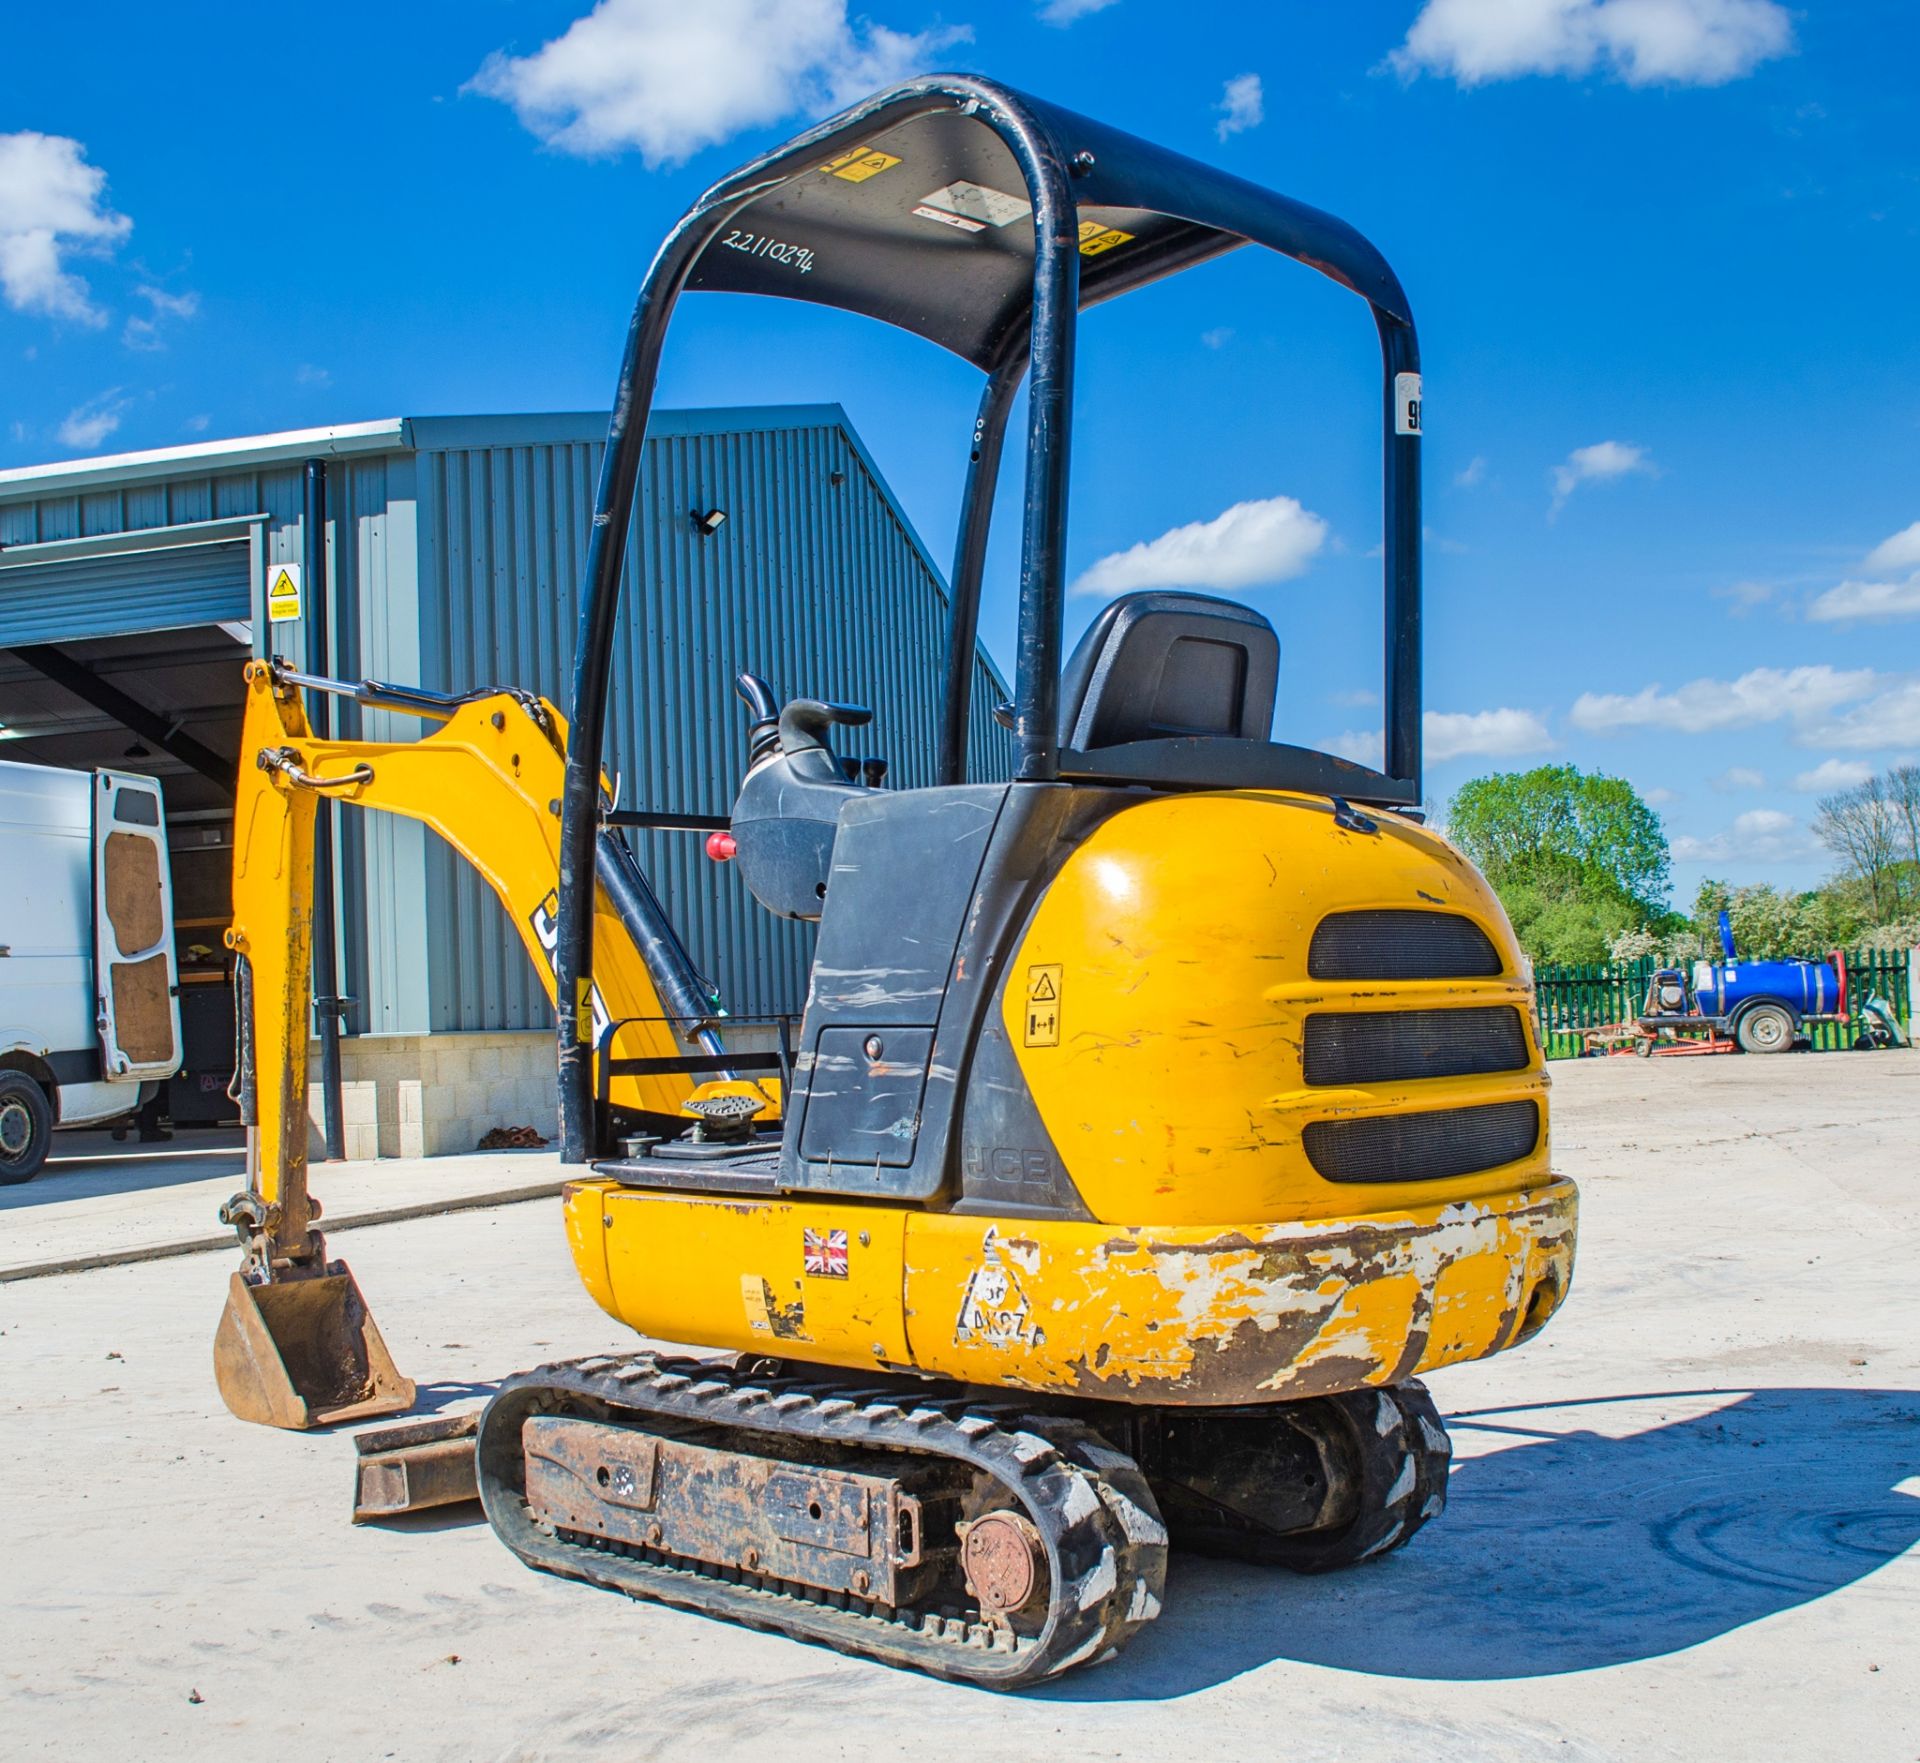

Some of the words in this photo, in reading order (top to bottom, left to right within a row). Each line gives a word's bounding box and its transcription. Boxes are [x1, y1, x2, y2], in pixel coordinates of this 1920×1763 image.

[722, 230, 815, 274] 22110294
[1408, 399, 1422, 430] 9
[966, 1146, 1051, 1184] JCB
